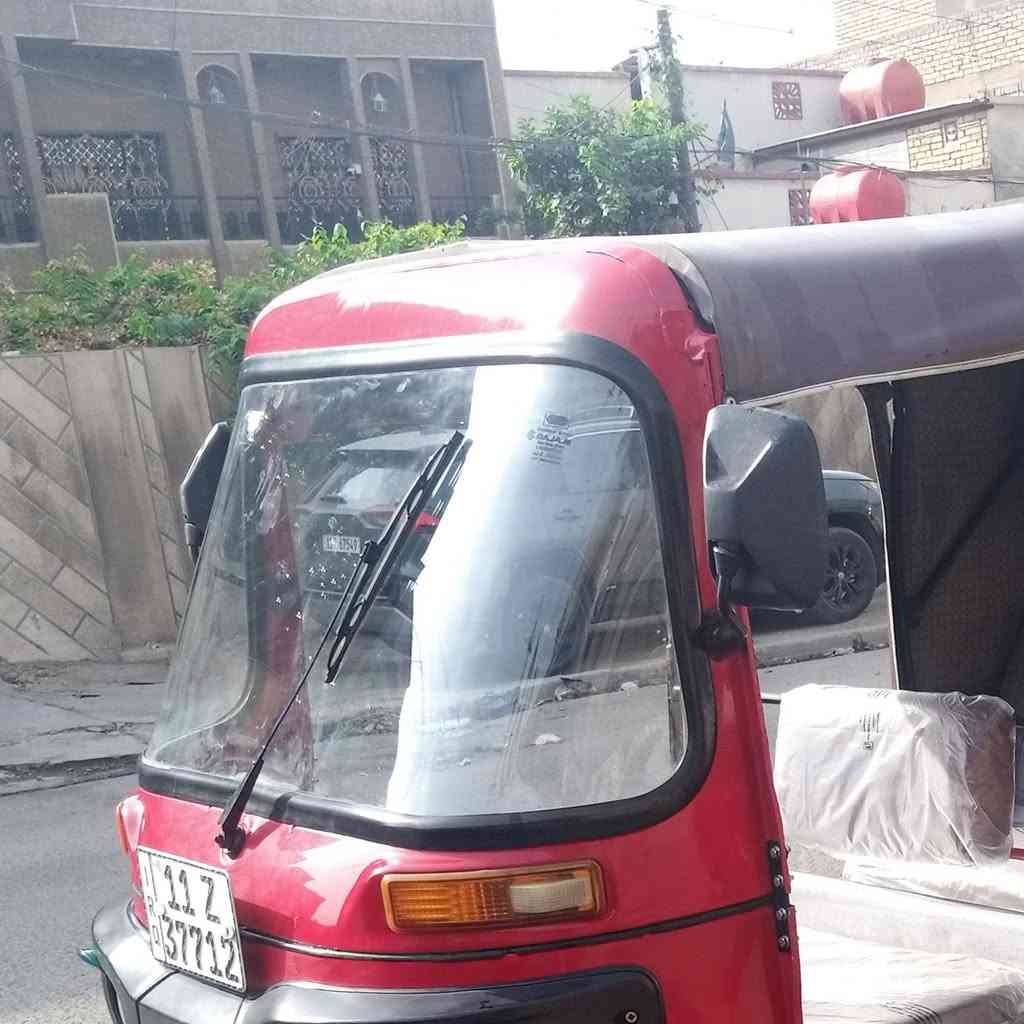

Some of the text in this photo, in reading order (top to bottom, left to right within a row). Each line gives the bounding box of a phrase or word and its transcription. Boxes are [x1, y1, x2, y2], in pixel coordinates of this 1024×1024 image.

[164, 865, 221, 925] 11 Z
[162, 912, 240, 983] 37712
